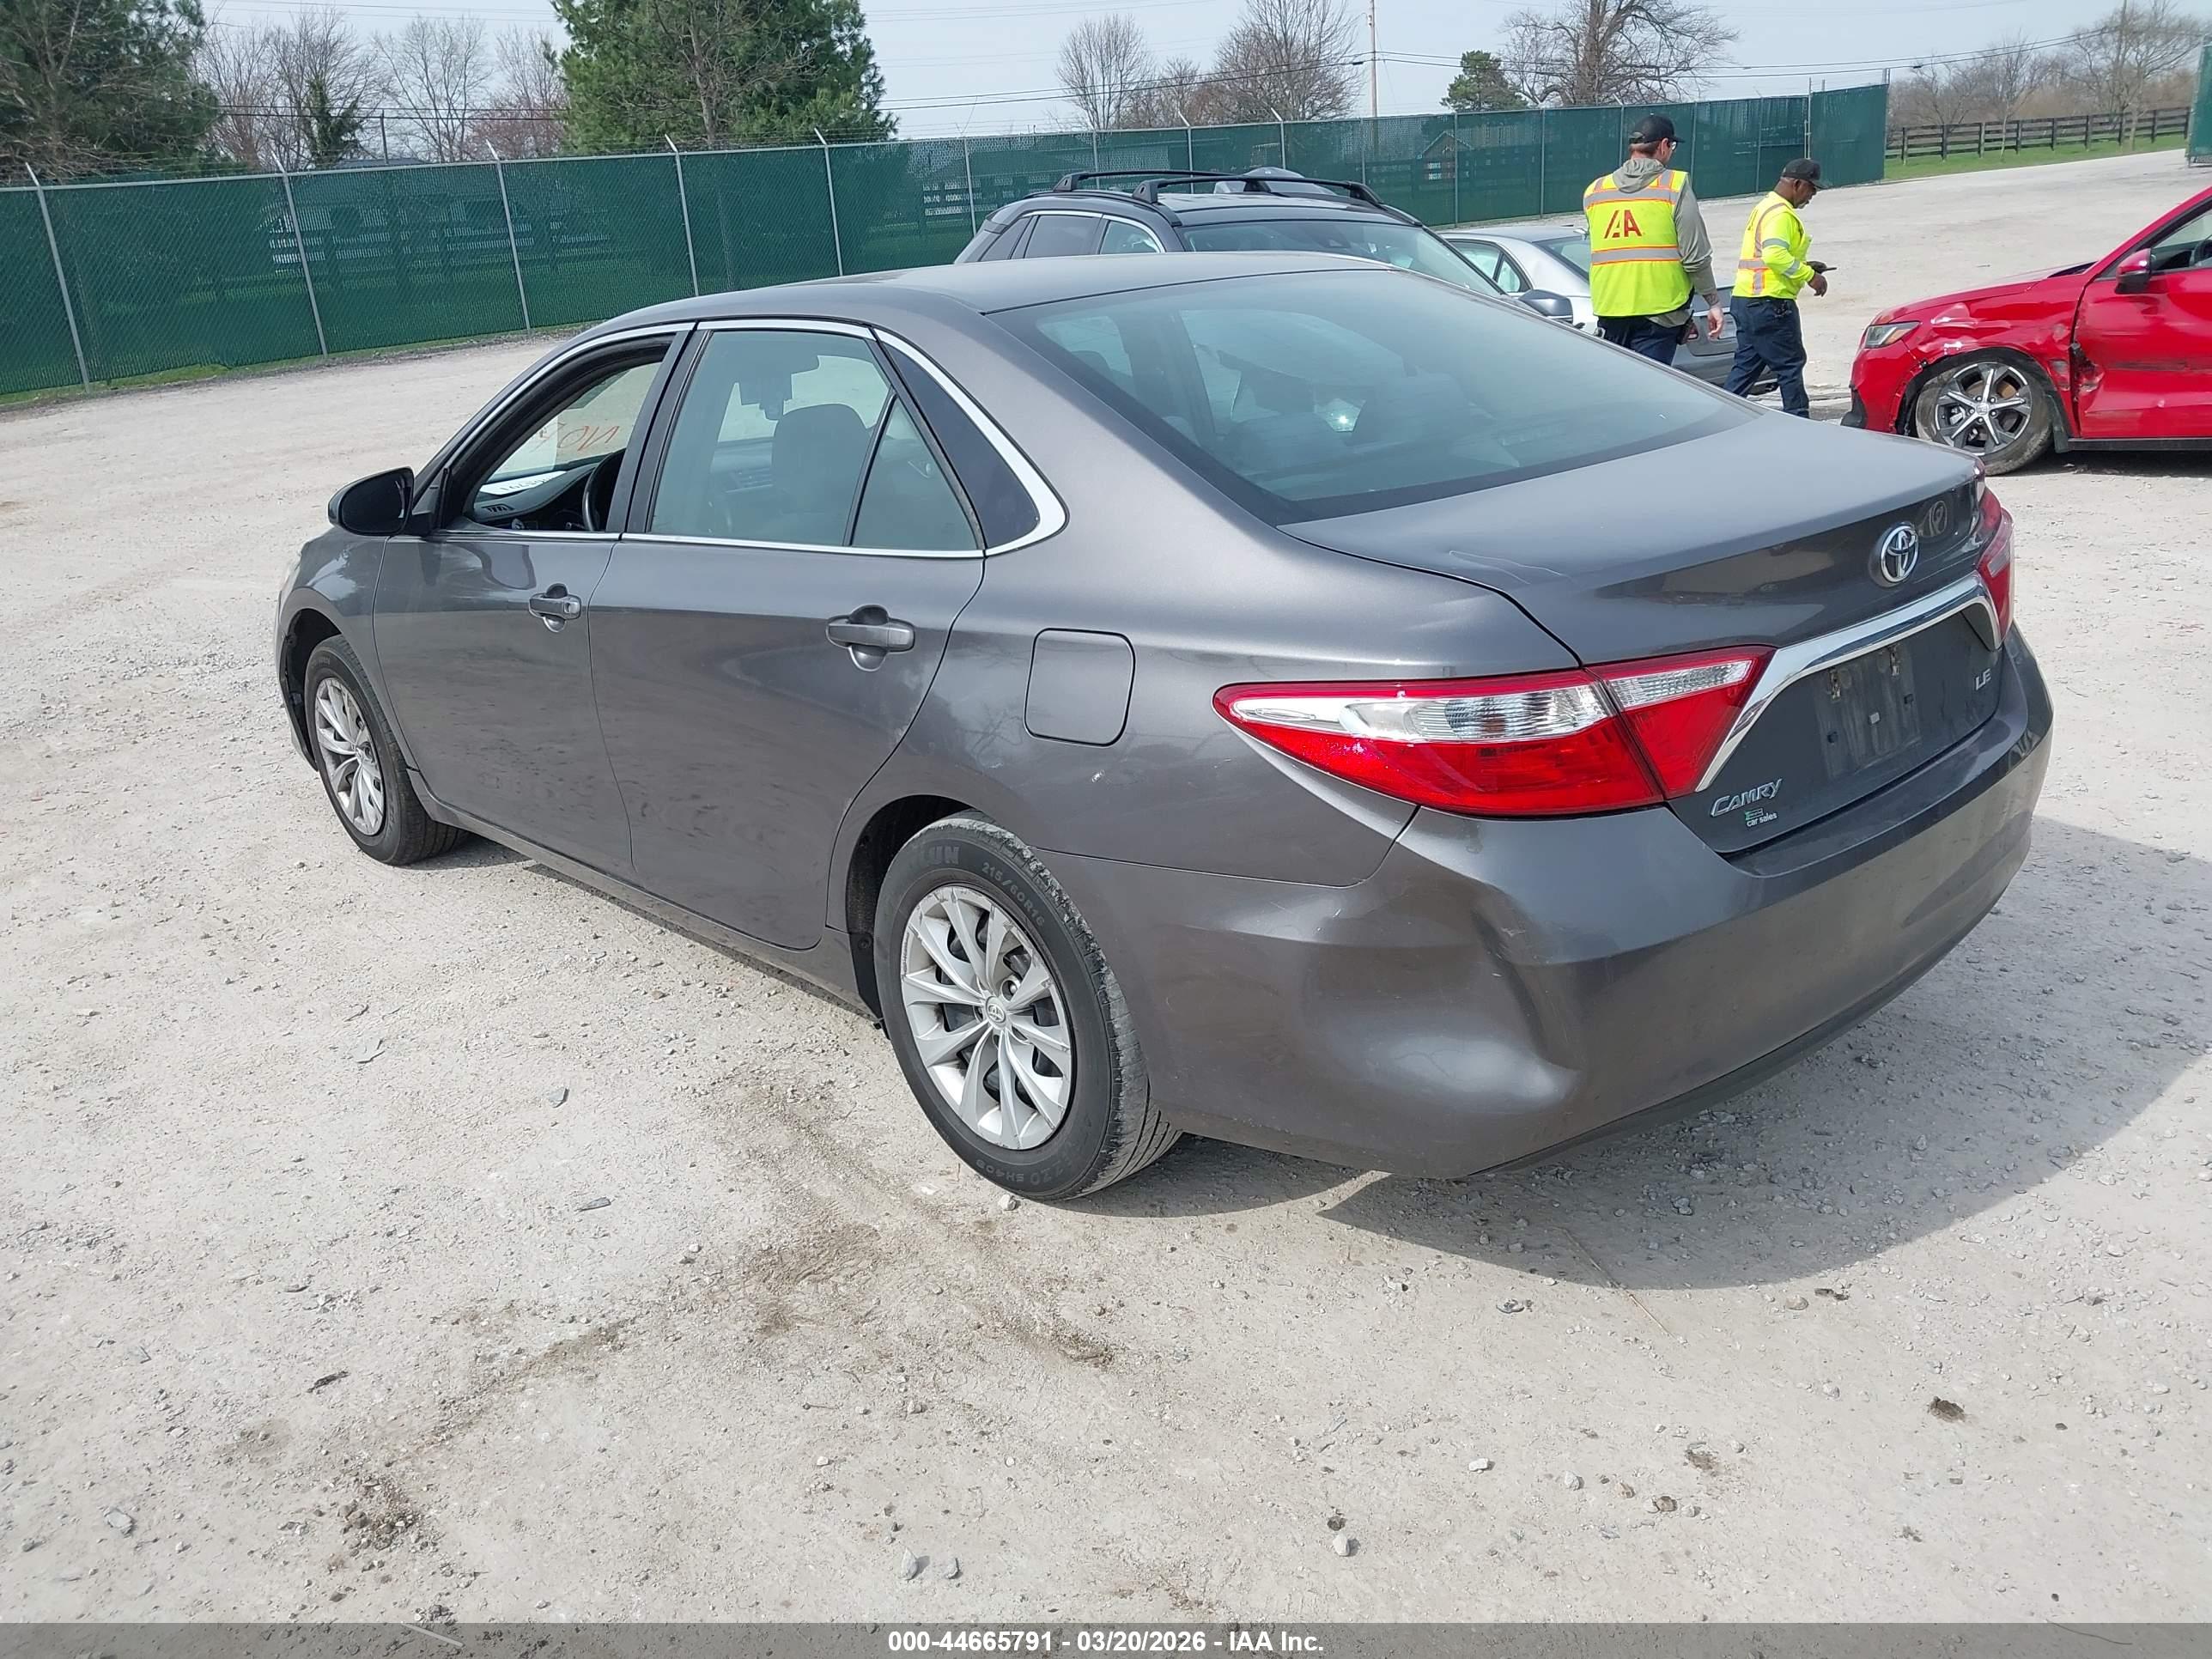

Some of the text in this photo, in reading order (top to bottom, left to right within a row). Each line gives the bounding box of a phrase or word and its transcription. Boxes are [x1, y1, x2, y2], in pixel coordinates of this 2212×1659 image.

[1976, 668, 1992, 690] LE
[1710, 778, 1782, 817] CAMRY
[1747, 818, 1759, 828] car
[1759, 812, 1778, 823] sales
